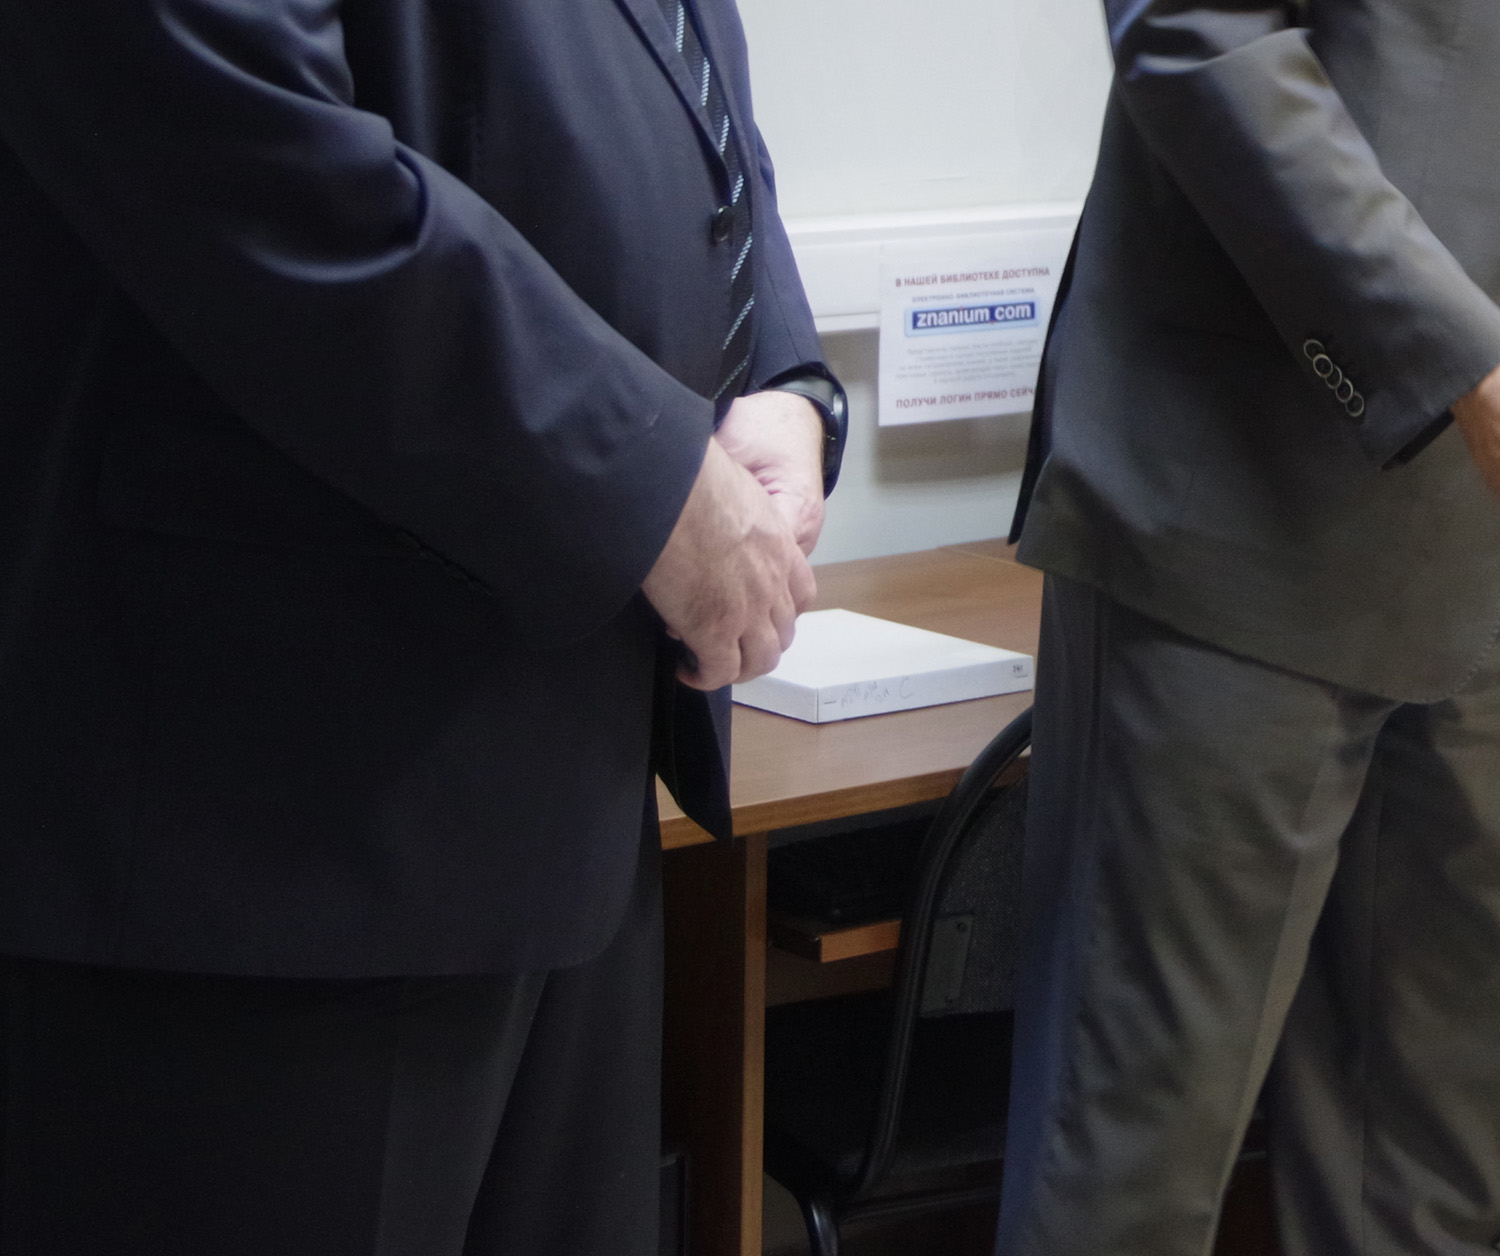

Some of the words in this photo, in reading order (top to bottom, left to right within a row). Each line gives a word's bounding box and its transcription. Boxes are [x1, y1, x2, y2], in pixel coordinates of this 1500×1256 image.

[895, 277, 902, 288] В
[904, 274, 938, 286] НАШЕЙ
[940, 269, 1000, 284] БИБЛИОТЕКЕ
[1001, 266, 1050, 280] ДОСТУПНА
[896, 395, 937, 409] ПОЛУЧИ
[939, 392, 972, 405] ЛОГИН
[974, 389, 1008, 402] ПРЯМО
[1010, 386, 1034, 398] СЕЙЧ
